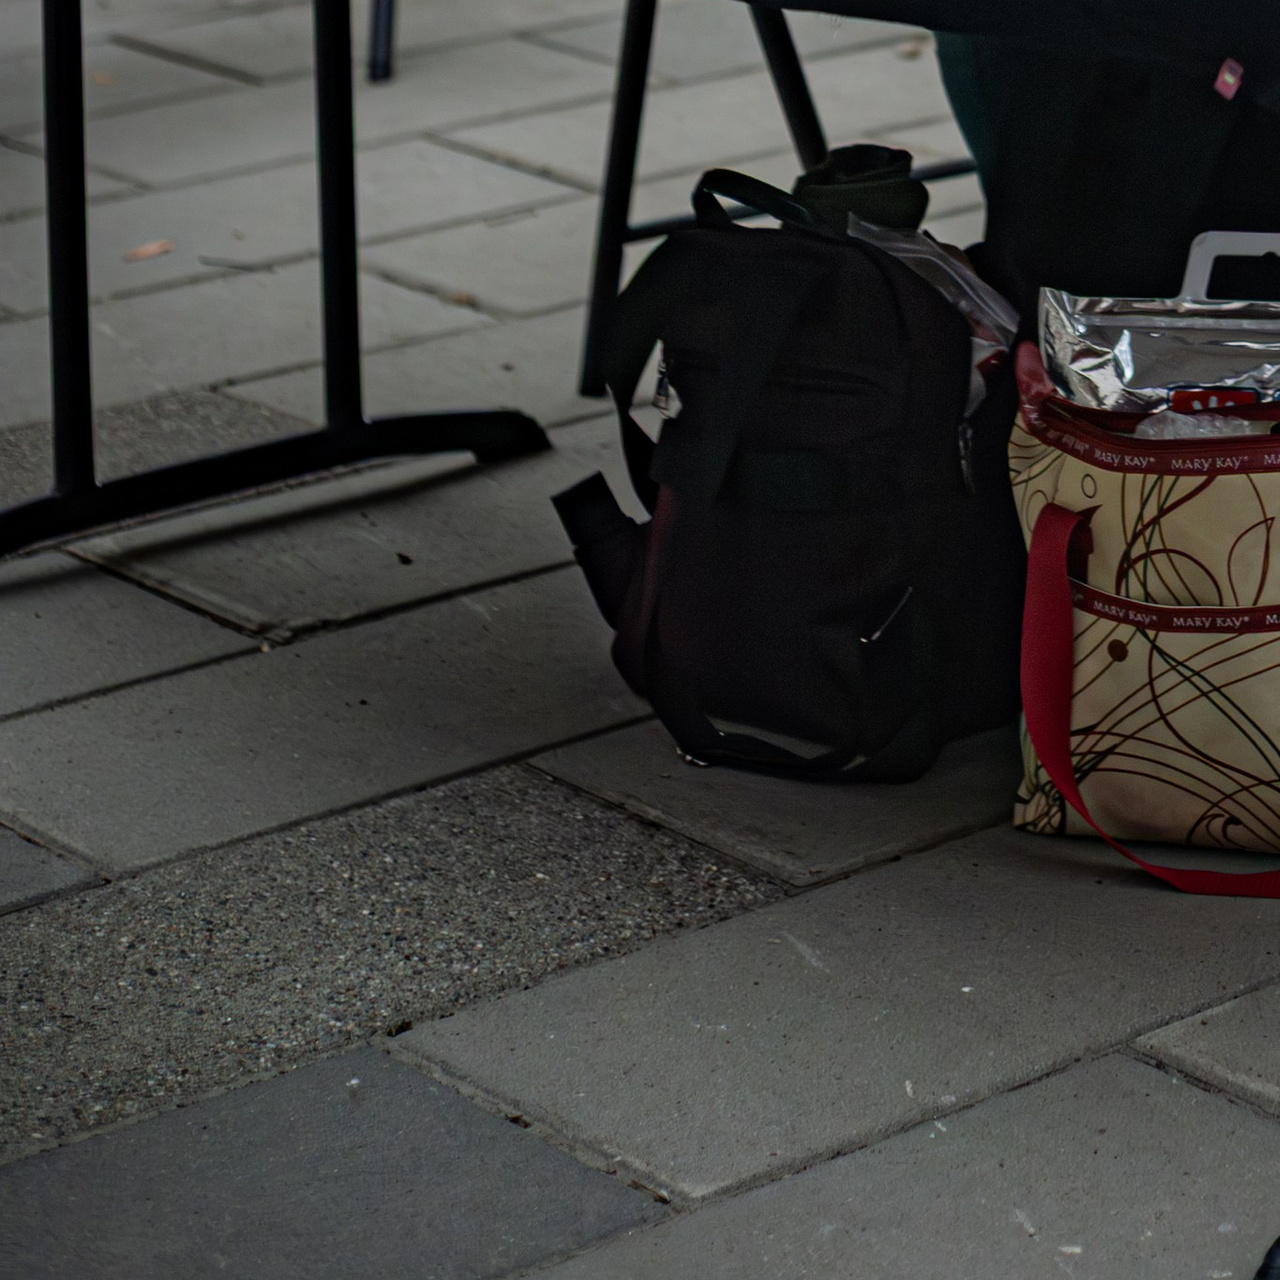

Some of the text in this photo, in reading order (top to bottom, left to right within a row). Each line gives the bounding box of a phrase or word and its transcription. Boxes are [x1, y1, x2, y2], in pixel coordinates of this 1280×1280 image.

[1094, 448, 1121, 467] MARY
[1171, 458, 1212, 471] MARY
[1093, 600, 1126, 618] MARY
[1173, 617, 1213, 628] MARY
